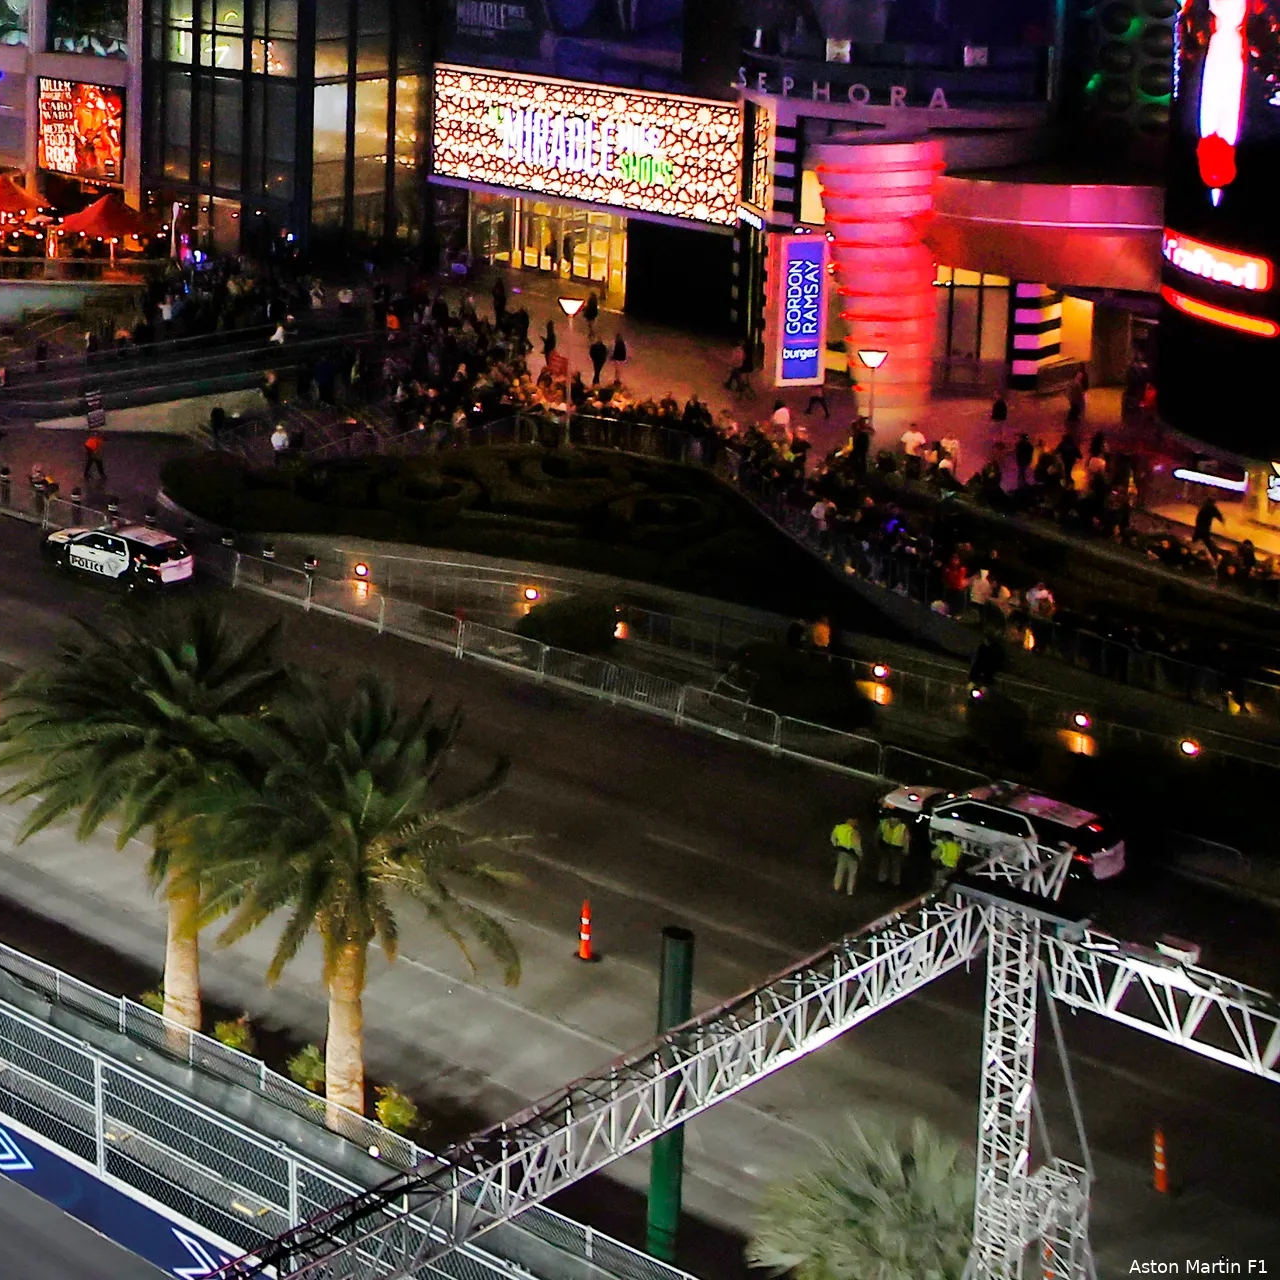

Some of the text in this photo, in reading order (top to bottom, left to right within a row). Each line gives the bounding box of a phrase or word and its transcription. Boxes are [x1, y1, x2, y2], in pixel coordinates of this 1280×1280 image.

[40, 78, 72, 92] KILLER
[738, 66, 949, 110] SEPHORA
[42, 101, 72, 111] CABO
[42, 110, 73, 120] WABO
[44, 133, 68, 147] FOOD
[502, 107, 663, 178] MIRACLE MILE
[45, 145, 78, 163] ROCK
[618, 153, 675, 187] SHOPS
[785, 260, 804, 335] GORDON
[801, 260, 820, 334] RAMSAY
[782, 347, 819, 361] burger
[69, 555, 105, 573] POLICE
